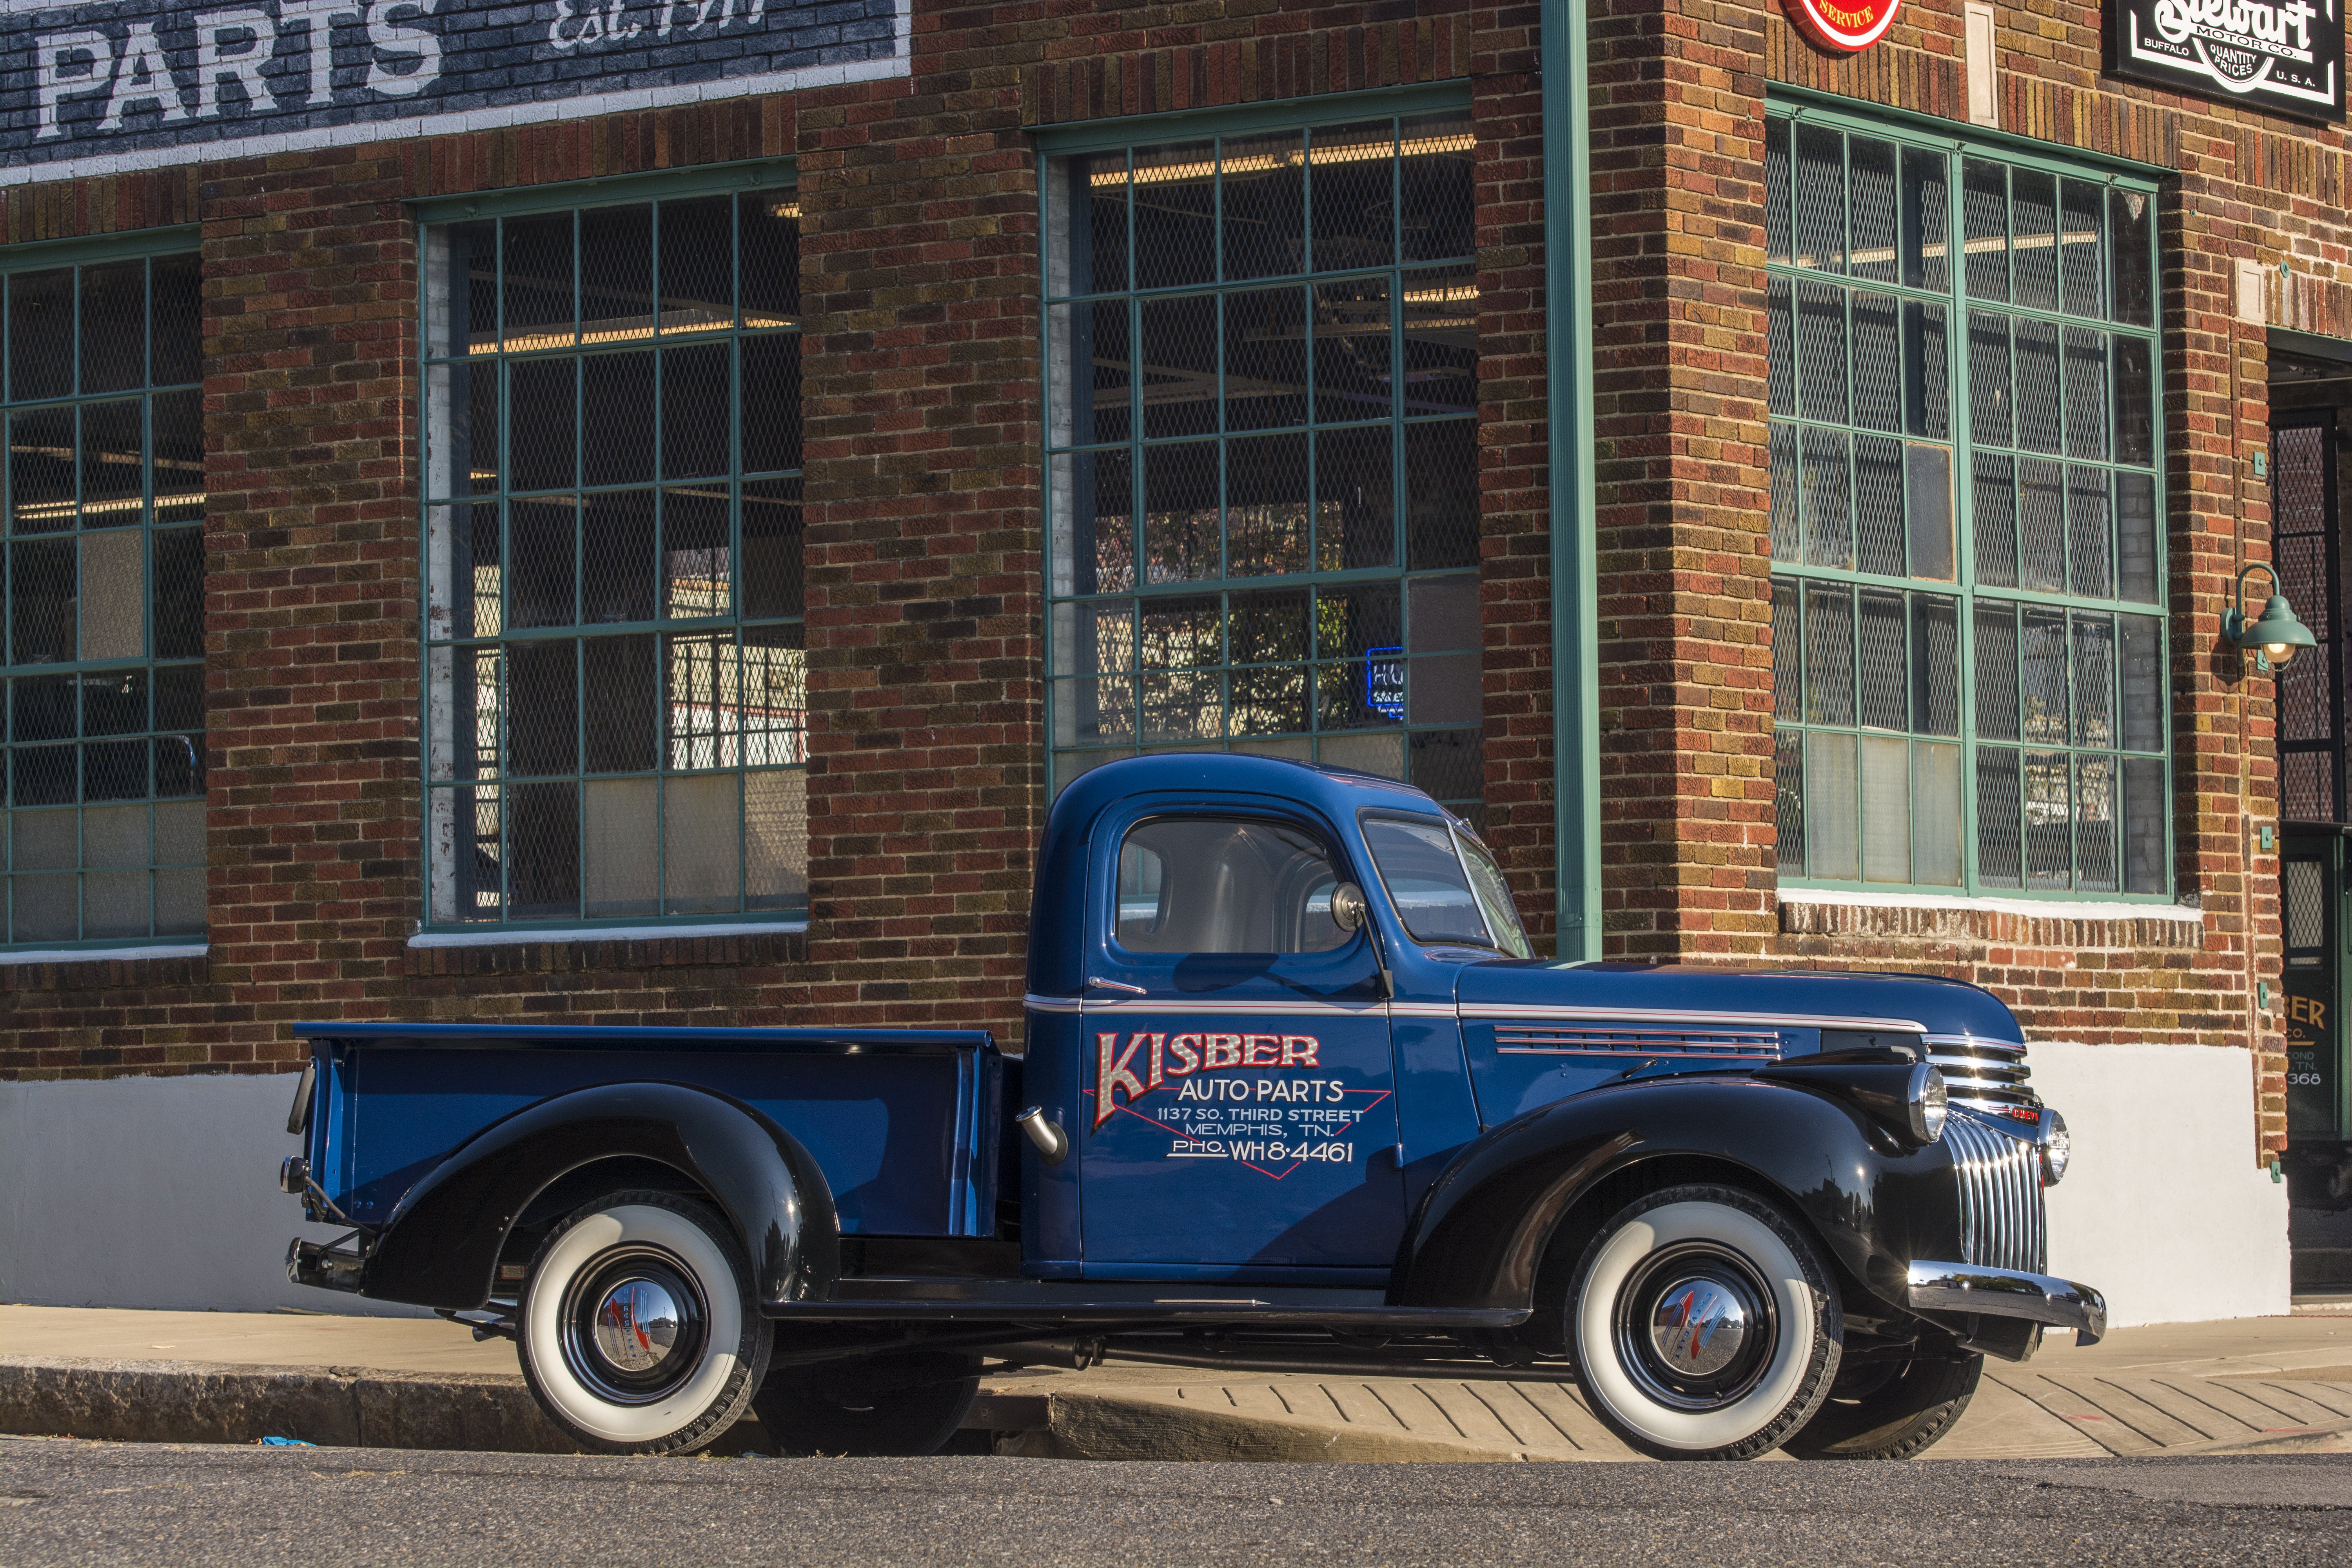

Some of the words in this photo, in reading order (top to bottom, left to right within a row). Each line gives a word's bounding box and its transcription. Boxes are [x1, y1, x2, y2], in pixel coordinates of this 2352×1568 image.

[1820, 0, 1874, 27] SERVICE
[2144, 38, 2189, 56] BUFFALO
[2196, 26, 2262, 49] MOTOR
[2269, 44, 2297, 58] CO.
[2210, 44, 2257, 64] QUANTITY
[35, 0, 441, 138] PARTS
[2214, 55, 2252, 76] PRICES
[1092, 1033, 1320, 1130] KISBER
[1178, 1079, 1249, 1102] AUTO
[1257, 1080, 1343, 1102] PARTS
[1158, 1108, 1192, 1120] 1137
[1195, 1108, 1224, 1120] SO.
[1228, 1109, 1283, 1121] THIRD
[1288, 1109, 1364, 1122] STREET
[1186, 1123, 1288, 1139] MEMPHIS,
[1298, 1125, 1335, 1137] TN.
[1173, 1140, 1226, 1153] PHO.
